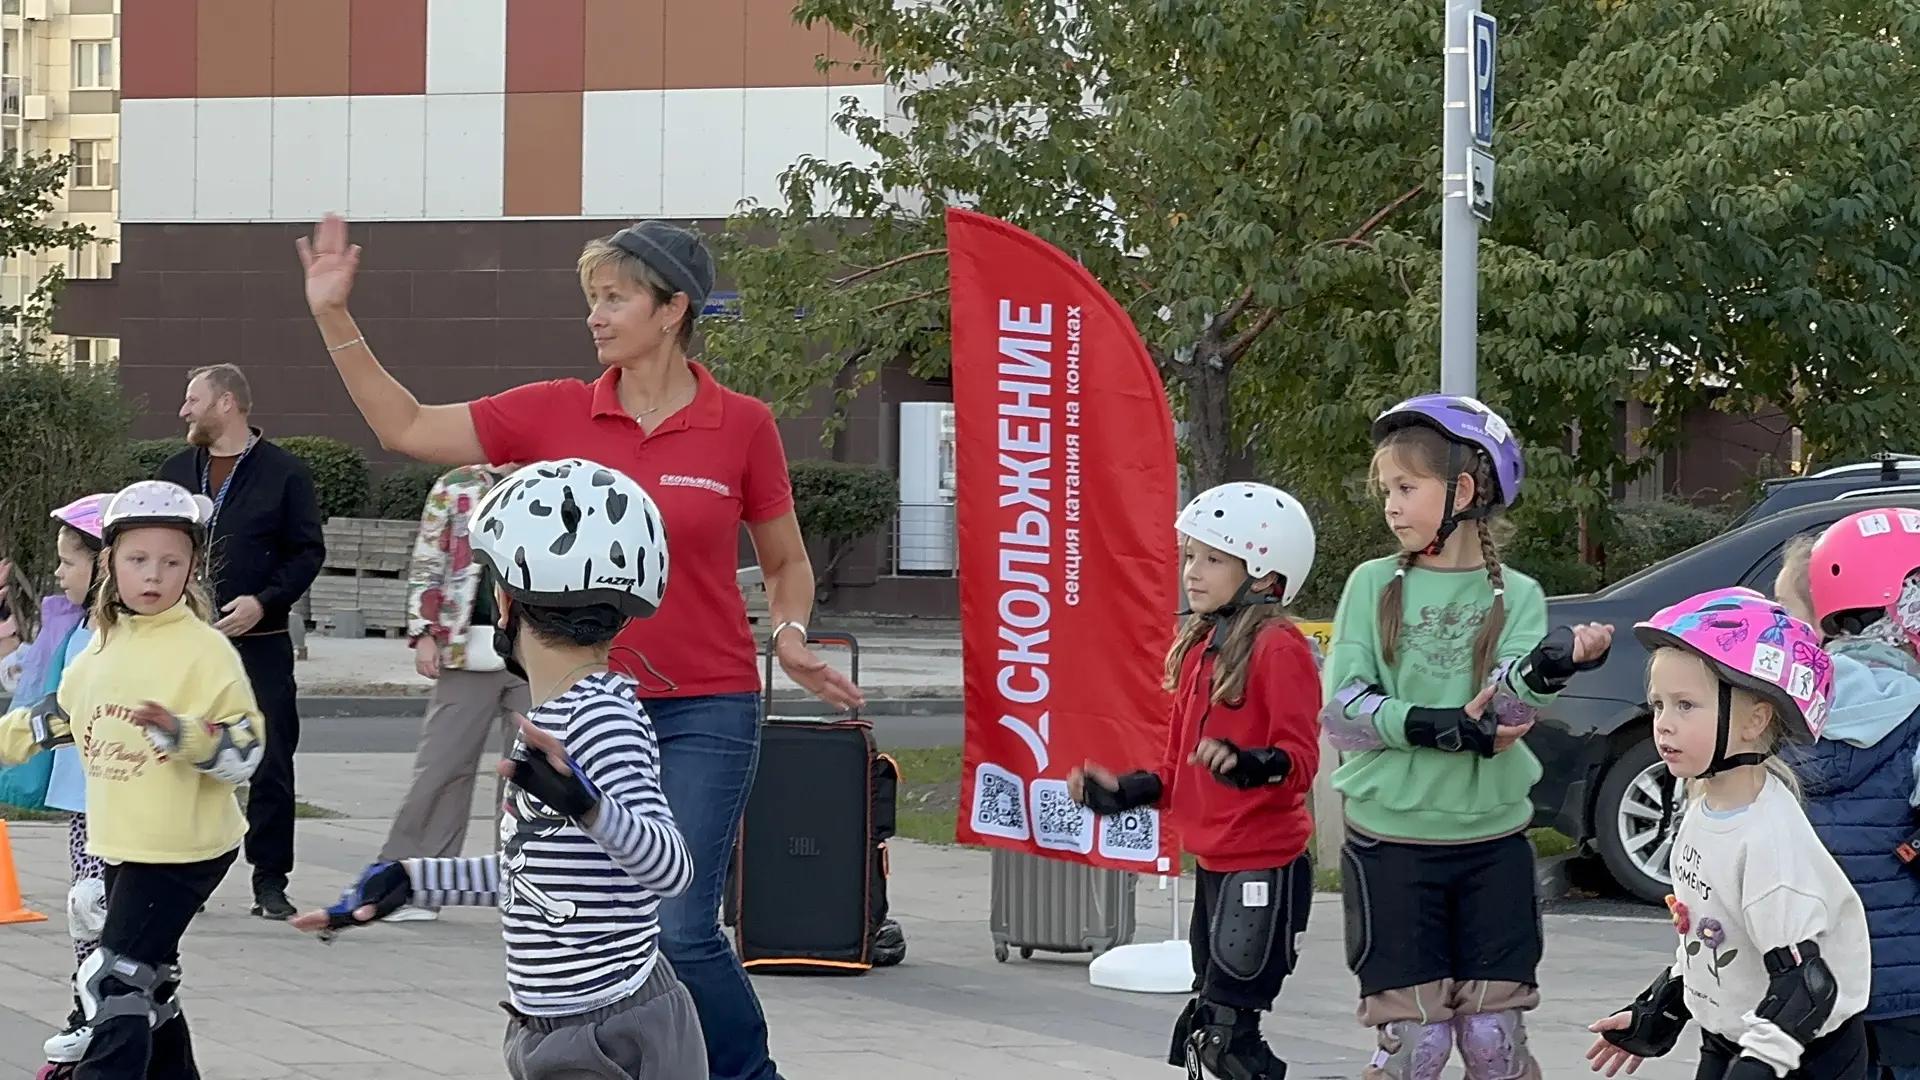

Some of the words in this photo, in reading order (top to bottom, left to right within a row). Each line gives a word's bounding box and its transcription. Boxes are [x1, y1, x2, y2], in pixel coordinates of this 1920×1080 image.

[1477, 24, 1491, 134] P
[1066, 305, 1081, 394] коньках
[1066, 401, 1080, 427] на
[997, 299, 1052, 703] СКОЛЬЖЕНИЕ
[1066, 434, 1080, 521] катания
[596, 576, 637, 586] LAZER
[1065, 528, 1082, 606] секция
[789, 836, 821, 856] JBL
[1675, 865, 1712, 900] MOMENTS
